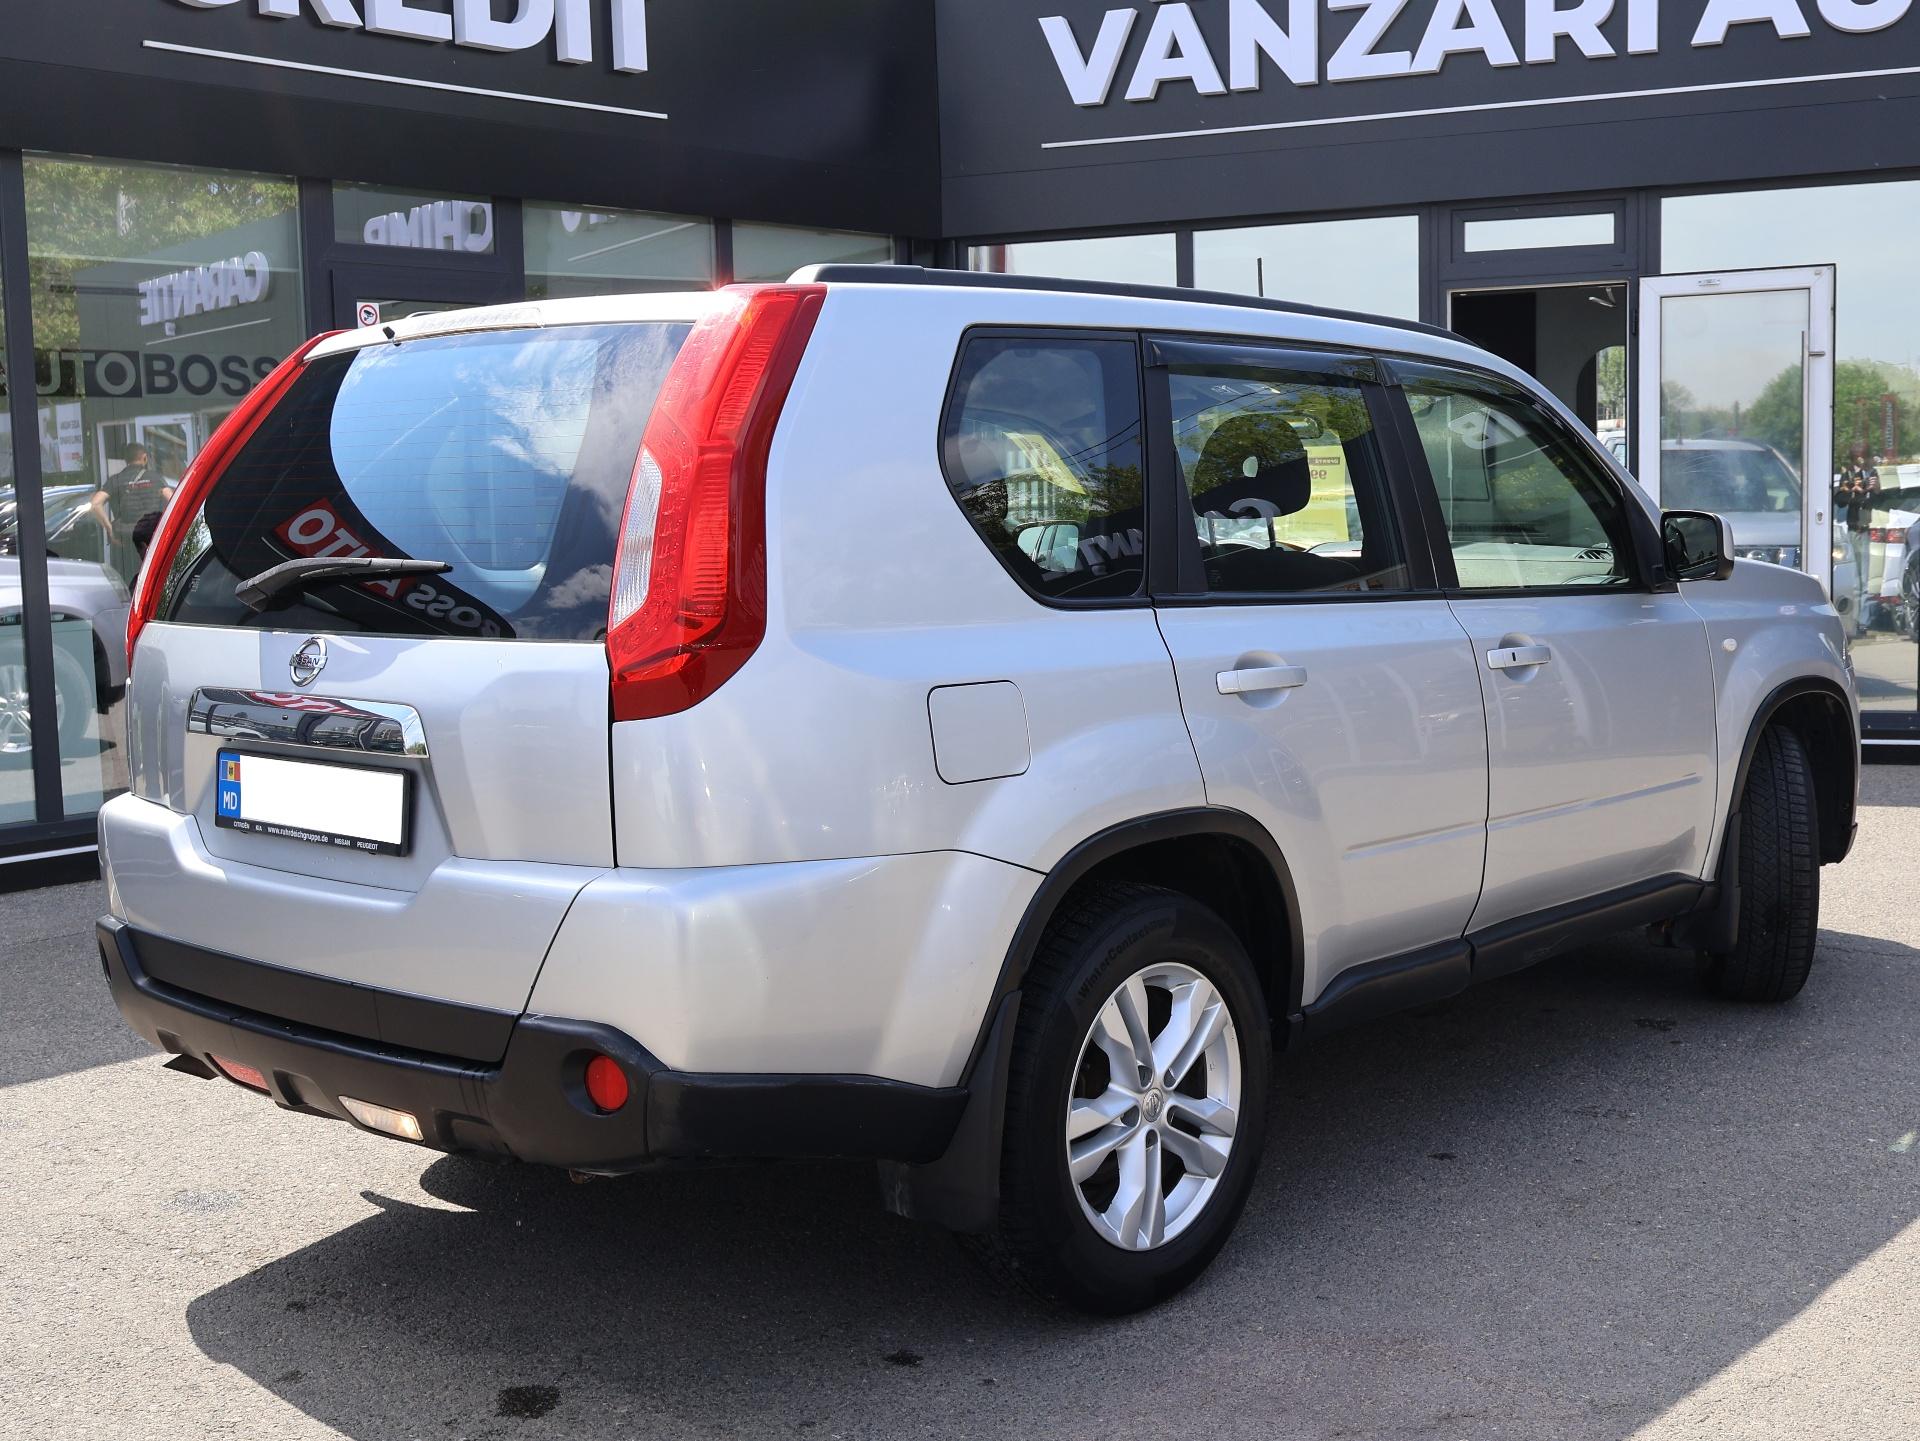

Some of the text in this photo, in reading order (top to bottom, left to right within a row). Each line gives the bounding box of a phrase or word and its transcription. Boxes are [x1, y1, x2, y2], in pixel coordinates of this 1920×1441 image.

[223, 790, 238, 810] MD
[334, 837, 351, 846] NISSAN
[356, 841, 379, 851] PEUGEOT
